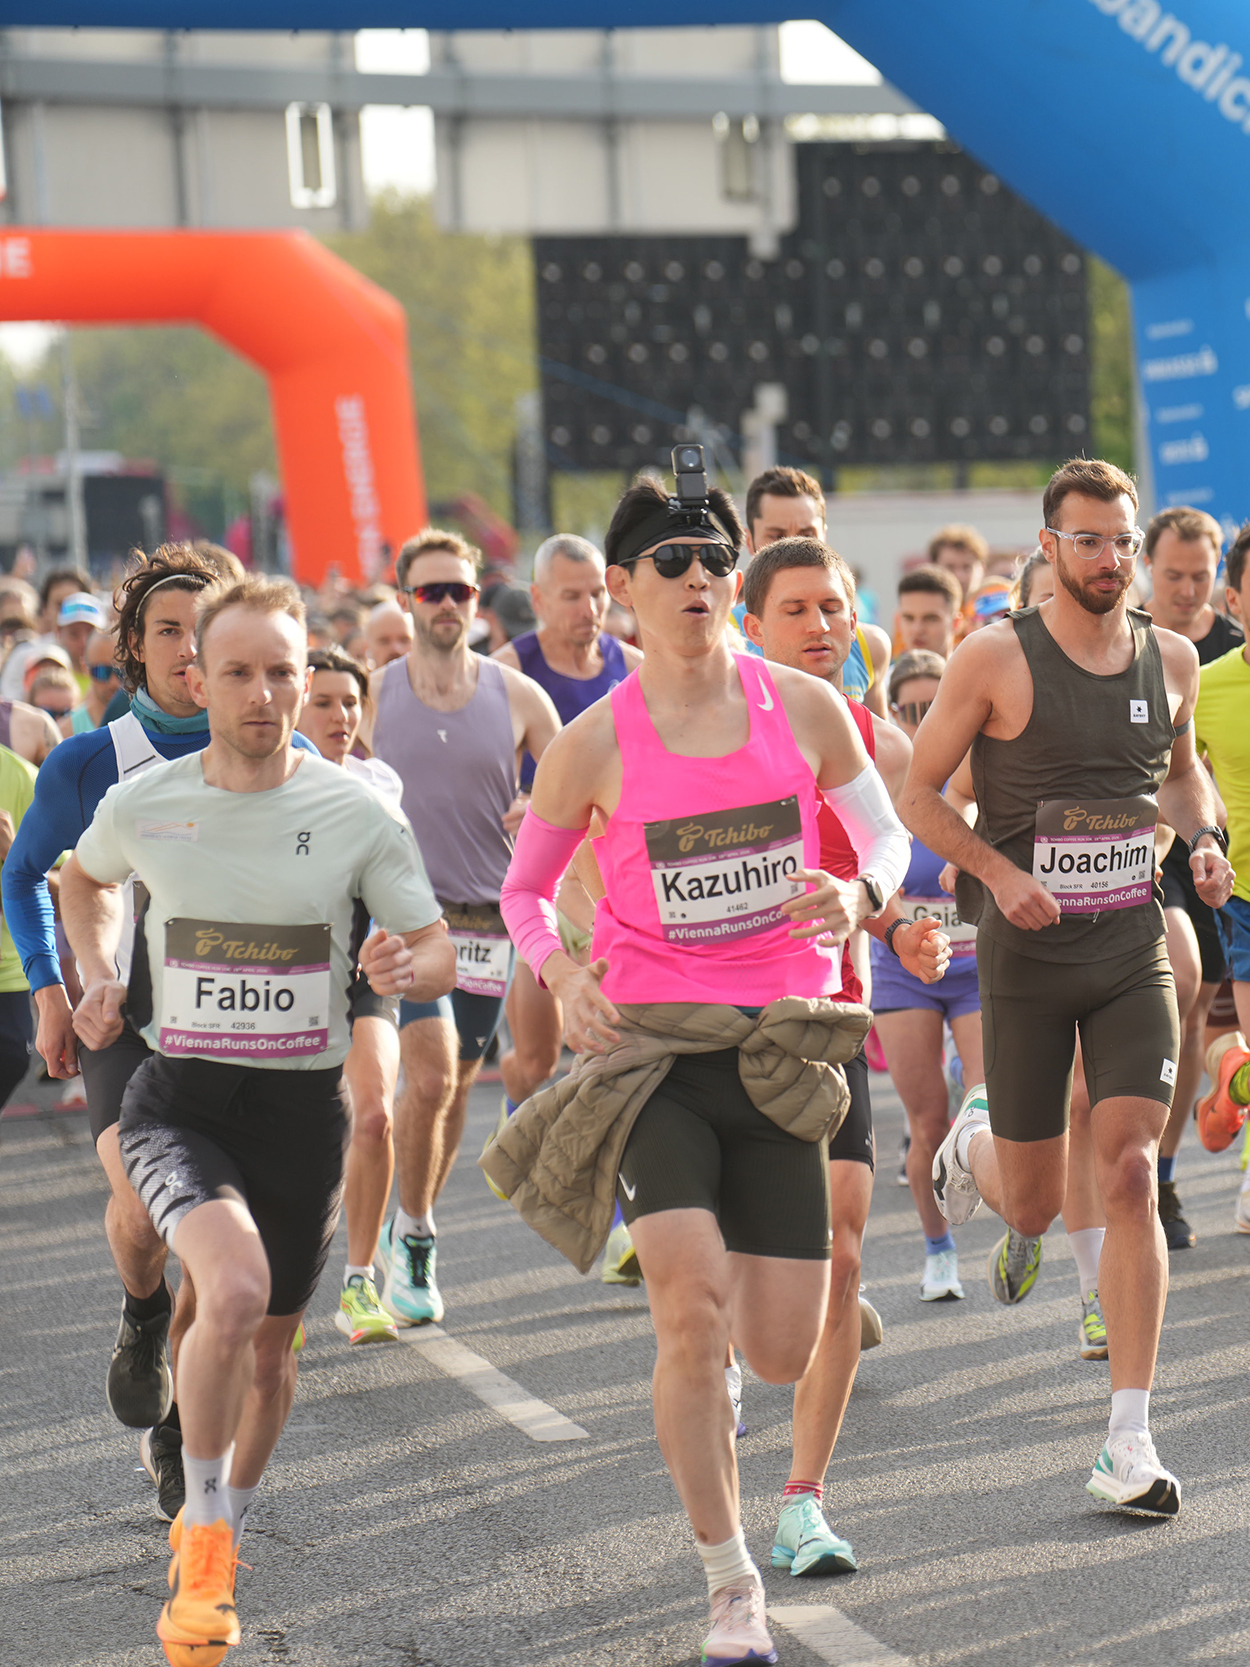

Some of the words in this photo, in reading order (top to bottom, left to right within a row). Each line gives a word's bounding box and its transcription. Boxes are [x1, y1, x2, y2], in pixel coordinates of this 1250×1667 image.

[1086, 813, 1139, 830] Tchibo
[704, 823, 774, 848] Tchibo
[1040, 843, 1147, 874] Joachim
[661, 856, 797, 902] Kazuhiro
[1090, 881, 1108, 889] 40156
[1057, 888, 1147, 907] ennaRunsOnCoffee
[726, 903, 748, 913] 41462
[668, 911, 786, 939] #ViennaRunsOnCo
[222, 941, 299, 961] Tchibo
[455, 941, 491, 963] ritz
[195, 977, 294, 1012] Fabio
[231, 1022, 255, 1030] 42936
[165, 1033, 320, 1050] #ViennaRunsOnCoffee
